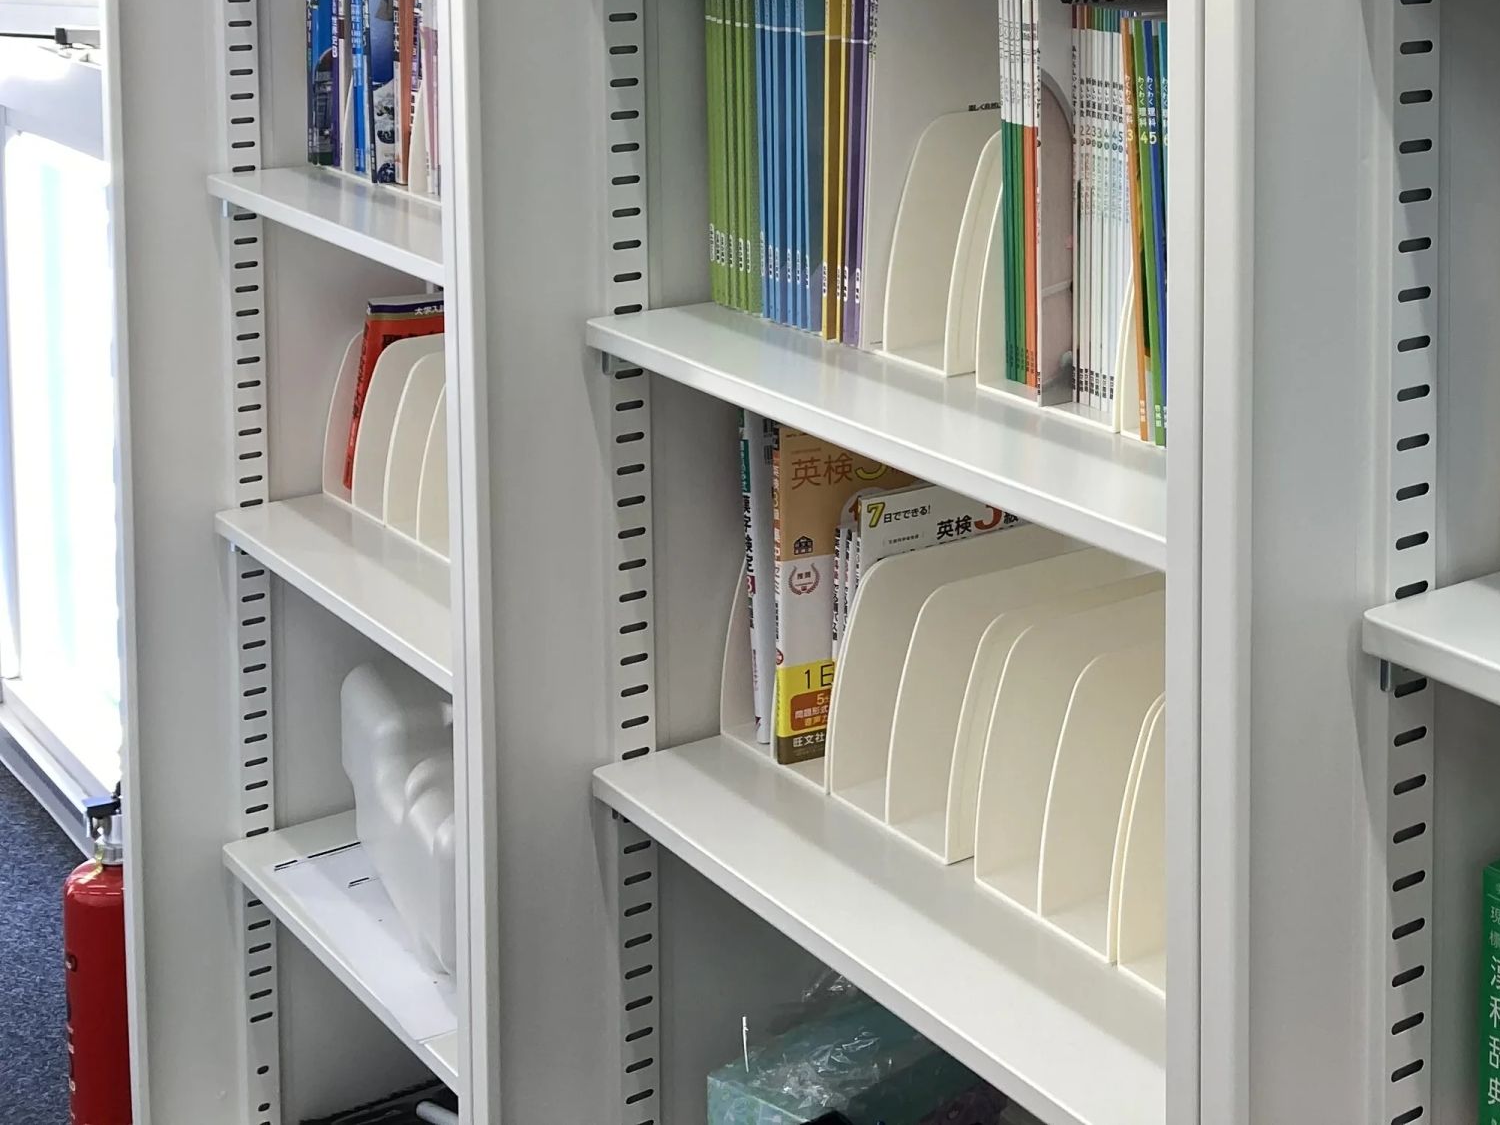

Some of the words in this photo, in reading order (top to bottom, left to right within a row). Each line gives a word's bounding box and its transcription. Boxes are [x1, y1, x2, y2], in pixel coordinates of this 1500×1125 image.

[1149, 131, 1157, 145] 5
[793, 733, 825, 747] 旺文社
